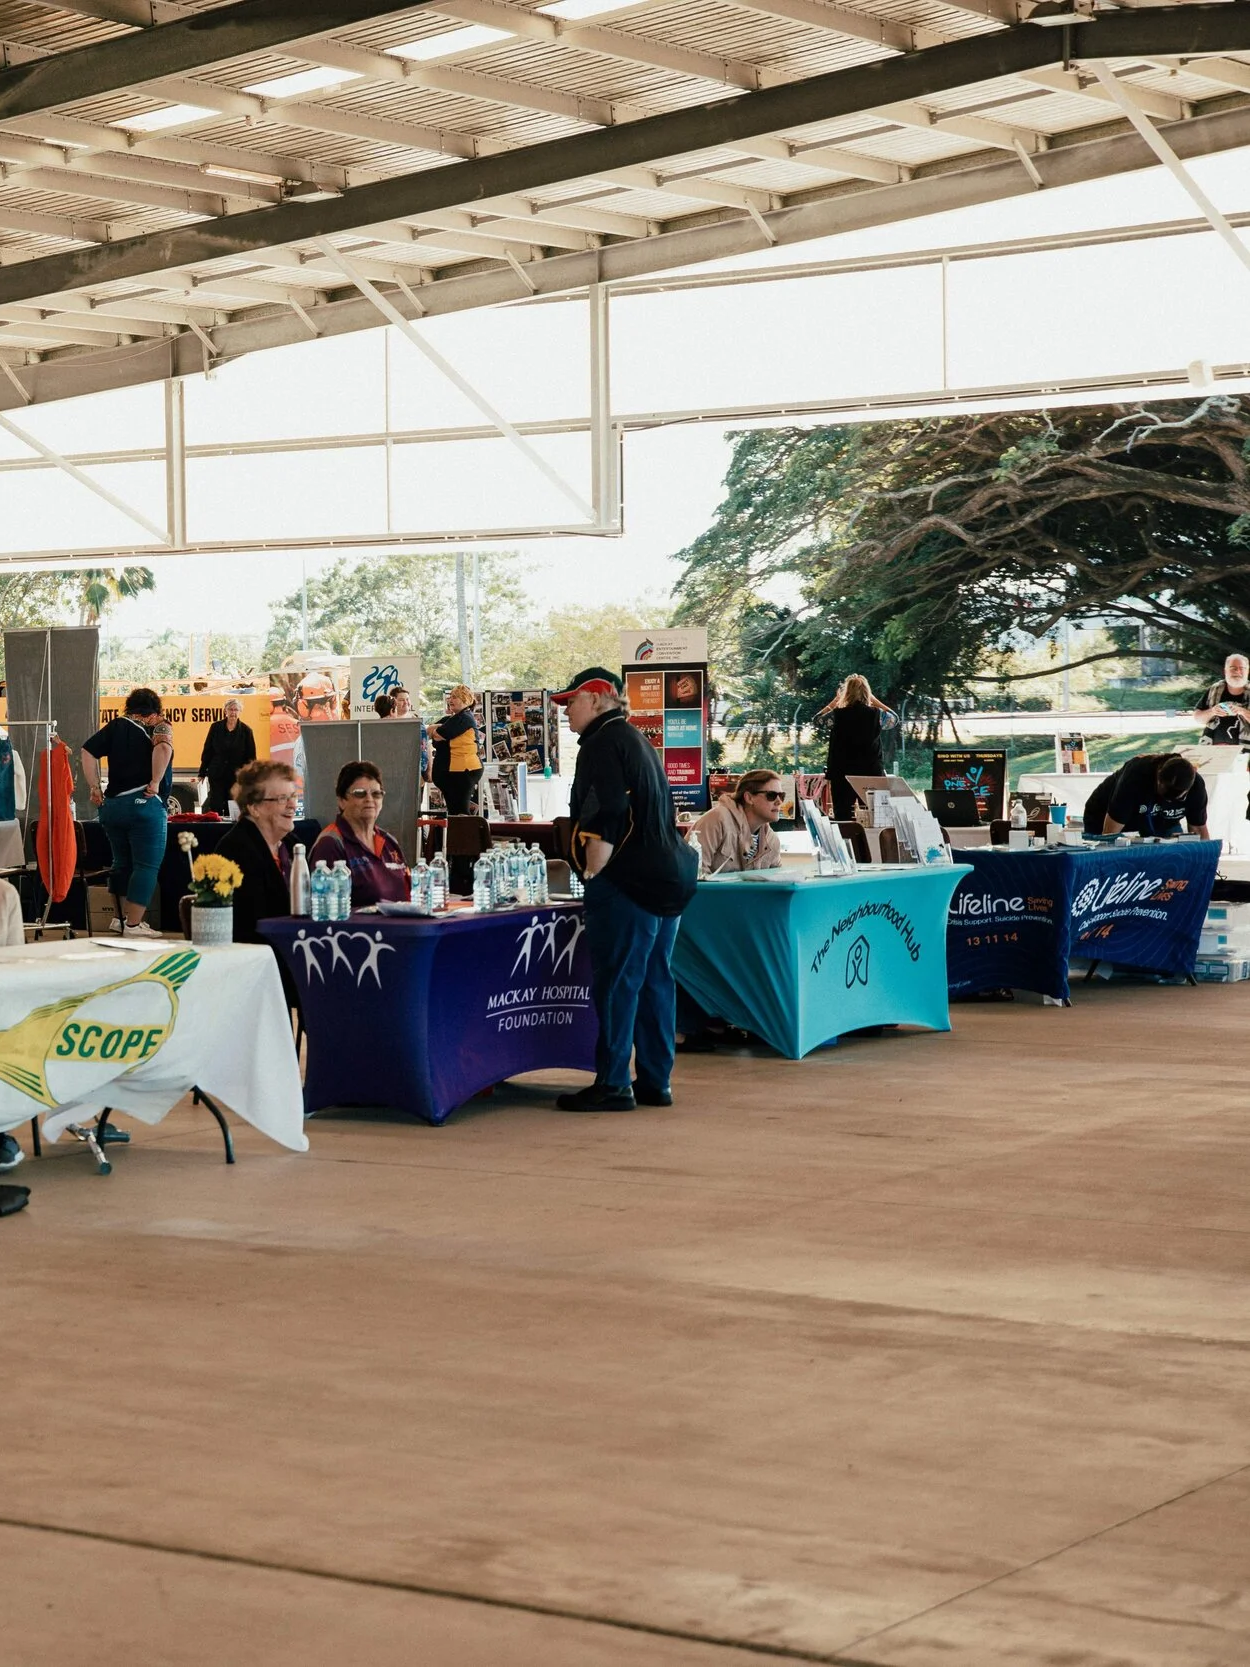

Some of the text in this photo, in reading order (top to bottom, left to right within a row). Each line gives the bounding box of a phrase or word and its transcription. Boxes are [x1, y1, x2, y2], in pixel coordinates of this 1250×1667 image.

[278, 723, 300, 734] SES
[1092, 872, 1162, 912] Lifeline
[810, 899, 922, 974] The Neighbourhood Hub
[966, 932, 1018, 946] 13 11 14
[487, 986, 590, 1010] MACKAY HOSPITAL
[498, 1011, 573, 1032] FOUNDATION
[55, 1023, 163, 1059] SCOPE
